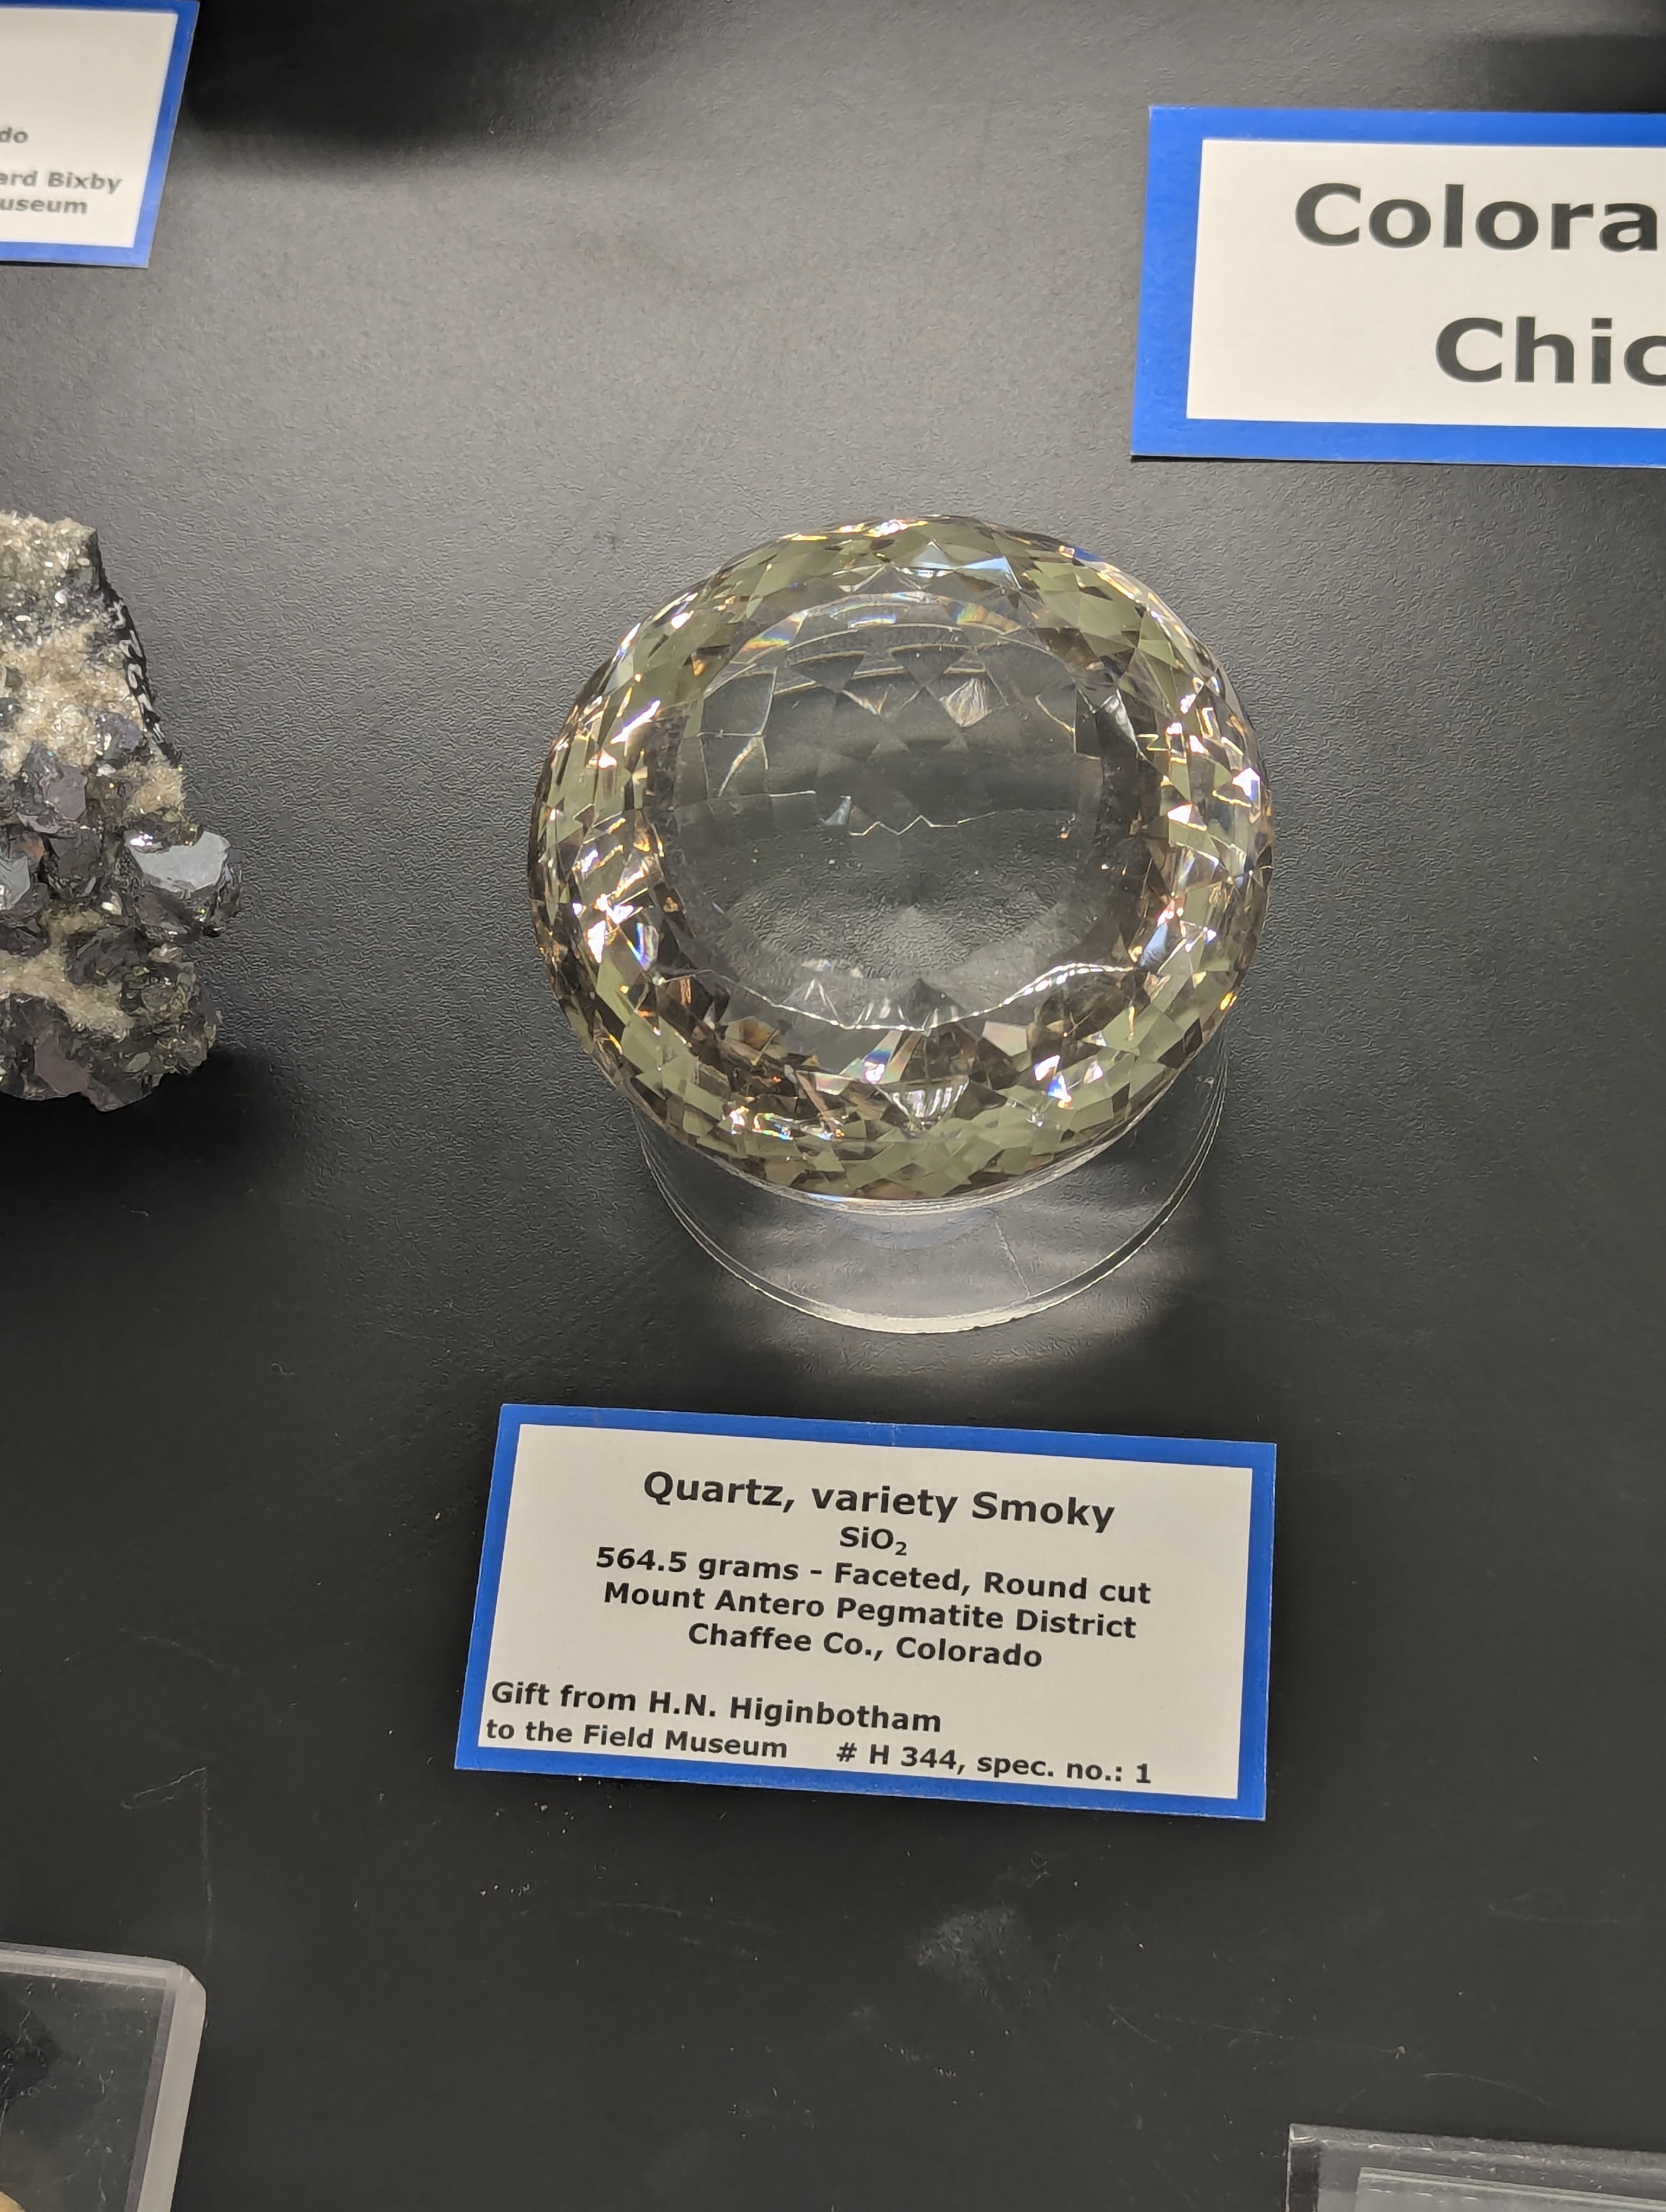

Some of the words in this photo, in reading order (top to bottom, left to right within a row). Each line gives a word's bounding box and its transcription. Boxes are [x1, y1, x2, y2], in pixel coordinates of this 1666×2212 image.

[48, 172, 123, 195] Bixby
[1296, 183, 1658, 251] Colora
[1436, 316, 1666, 386] Chic
[644, 1471, 794, 1513] Quartz,
[811, 1485, 958, 1523] variety
[972, 1491, 1115, 1533] Smoky
[596, 1546, 687, 1573] 564.5
[699, 1558, 799, 1580] grams
[835, 1562, 970, 1596] Faceted,
[984, 1572, 1087, 1600] Round
[1099, 1582, 1151, 1604] cut
[604, 1581, 706, 1609] Mount
[714, 1589, 824, 1617] Antero
[837, 1597, 1003, 1629] Pegmatite
[1016, 1609, 1137, 1638] District
[689, 1623, 811, 1652] Chaffee
[823, 1632, 883, 1661] Co.,
[896, 1637, 1042, 1667] Colorado
[492, 1681, 550, 1706] Gift
[560, 1684, 636, 1711] from
[649, 1690, 716, 1717] H.N.
[730, 1696, 940, 1732] Higinbotham
[486, 1719, 515, 1739] to
[526, 1721, 573, 1743] the
[584, 1724, 653, 1748] Field
[665, 1729, 787, 1758] Museum
[836, 1742, 857, 1762] #
[869, 1744, 889, 1765] H
[901, 1746, 965, 1775] 344,
[977, 1757, 1054, 1778] spec.
[1067, 1763, 1122, 1782] no.:
[1136, 1763, 1151, 1784] 1
